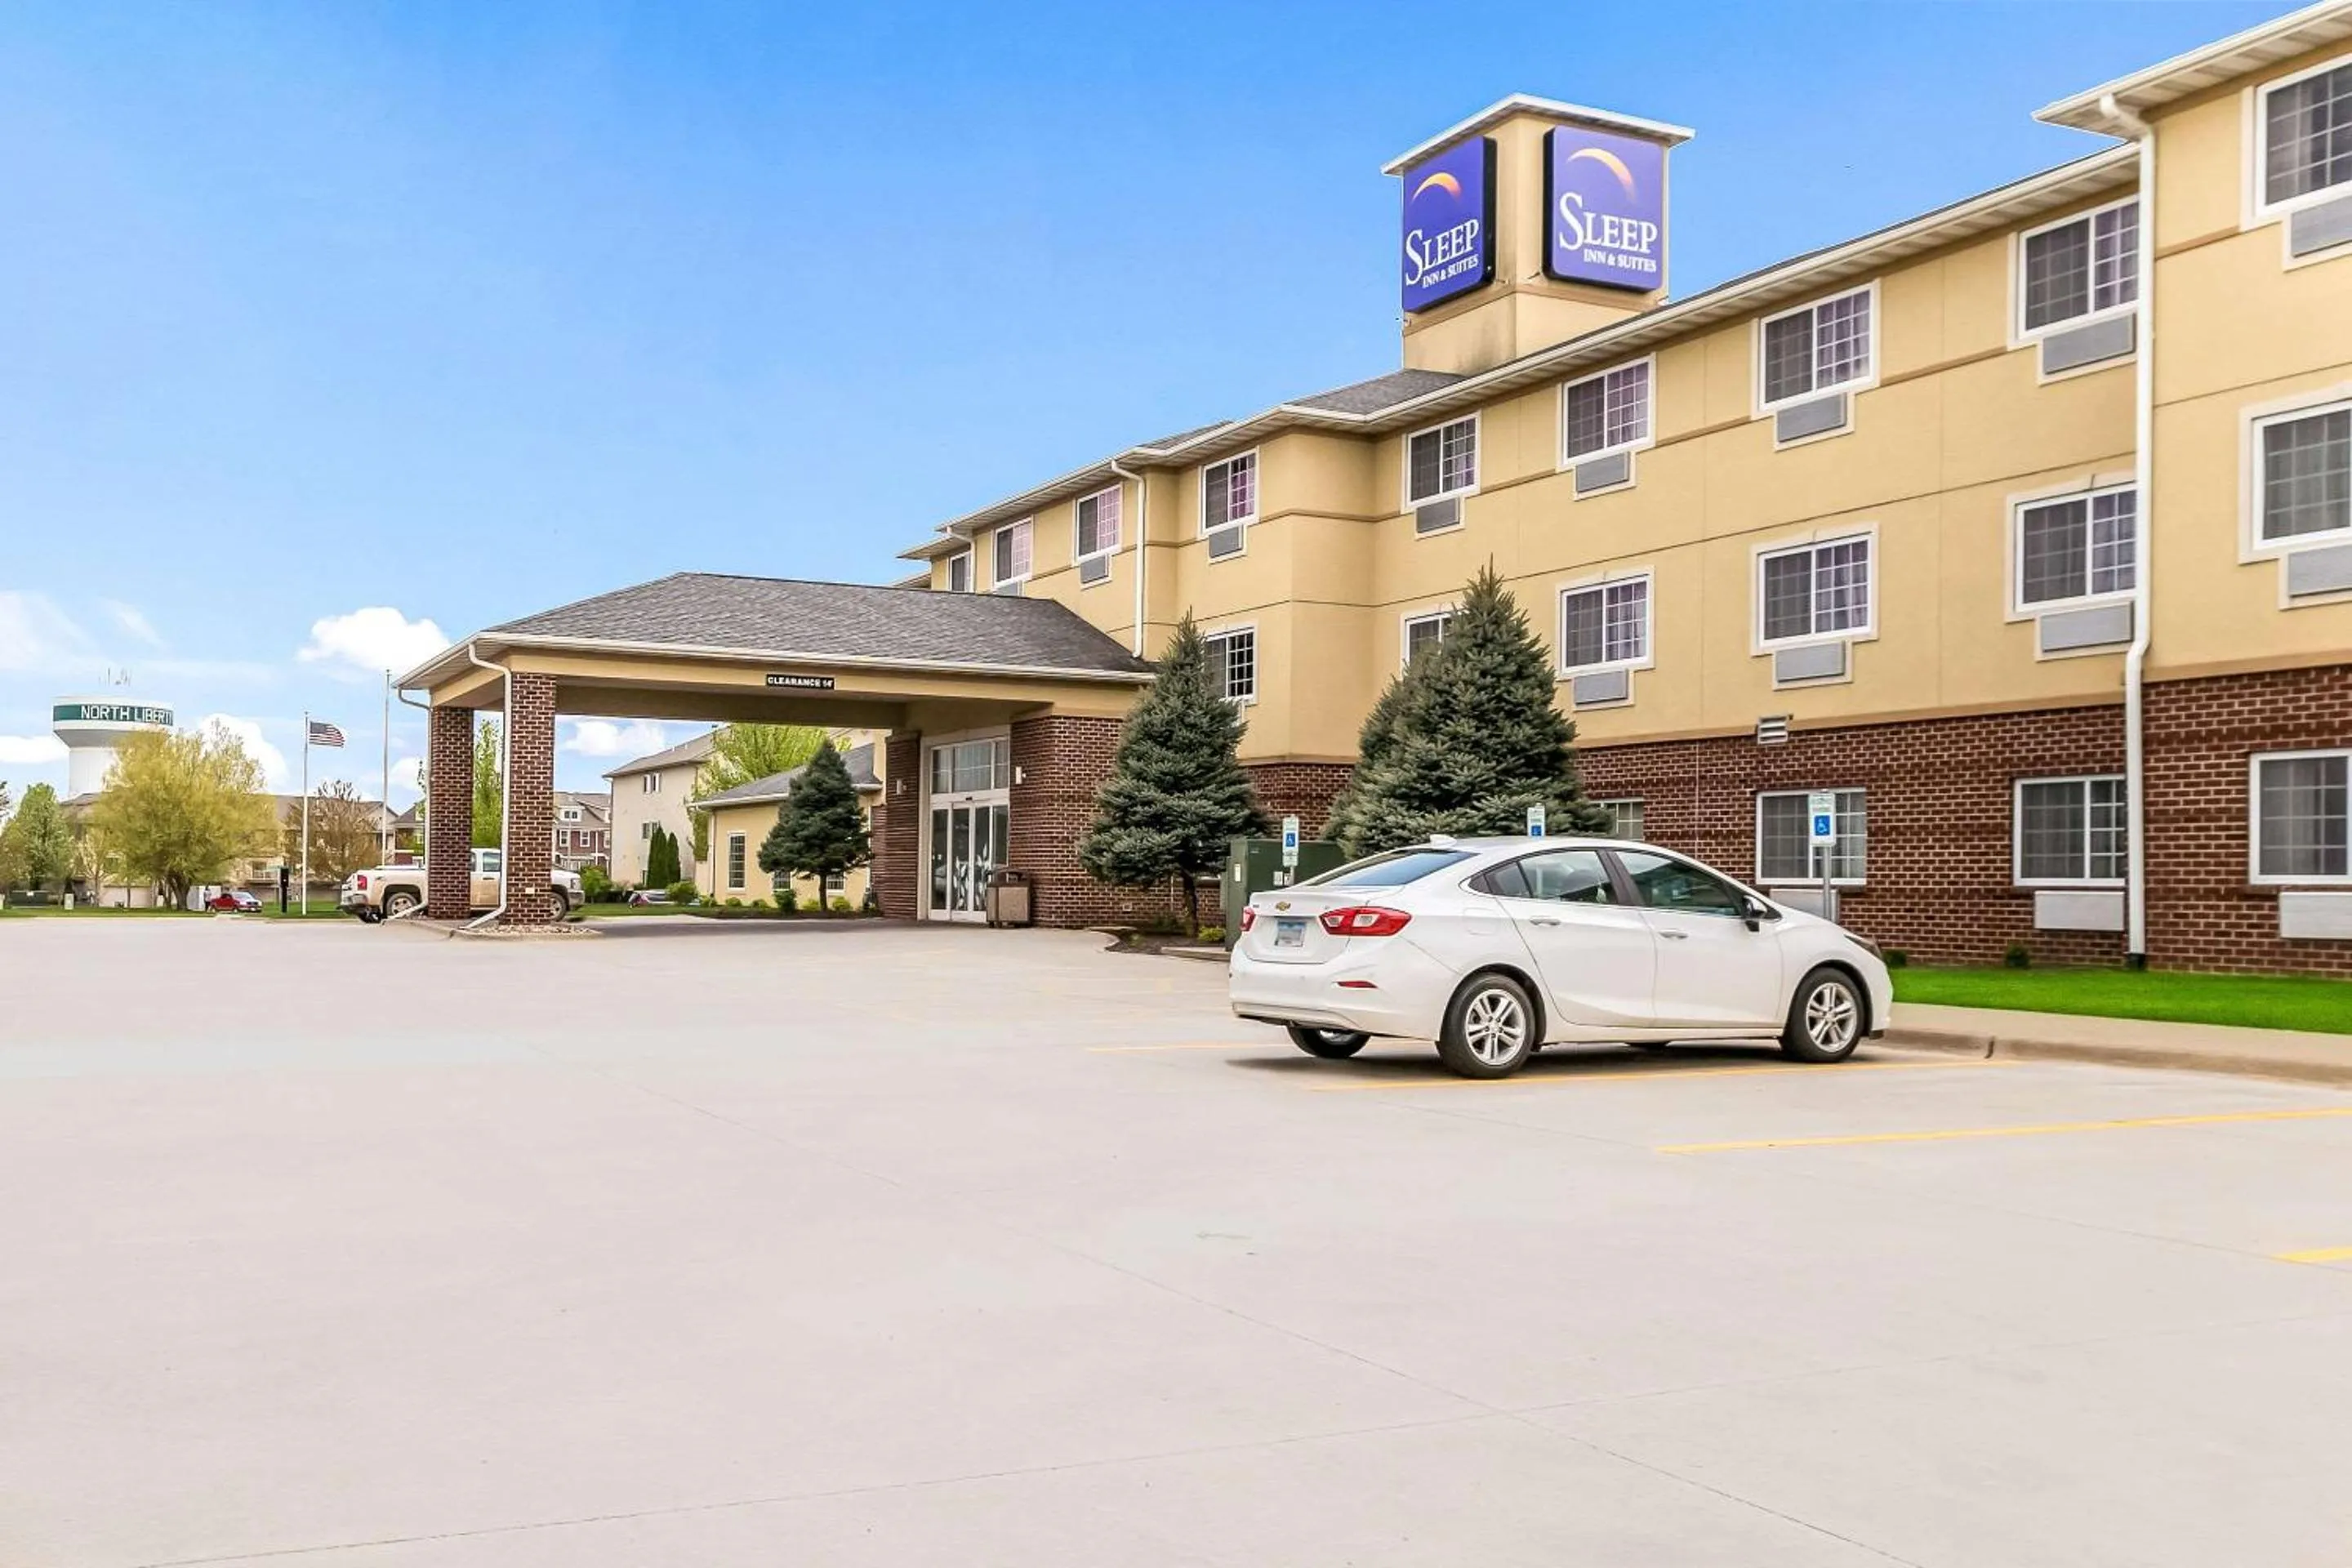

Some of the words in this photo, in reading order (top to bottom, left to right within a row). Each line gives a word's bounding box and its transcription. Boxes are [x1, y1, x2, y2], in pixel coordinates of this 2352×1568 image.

[1559, 192, 1658, 254] SLEEP
[1405, 219, 1479, 286] SLEEP
[1584, 248, 1606, 264] INN
[1607, 253, 1616, 266] &
[1617, 254, 1657, 273] SUITES
[1422, 270, 1440, 289] INN
[1441, 269, 1447, 281] &
[1448, 254, 1479, 278] SUITES
[768, 676, 821, 687] CLEARANCE
[81, 705, 130, 720] NORTH
